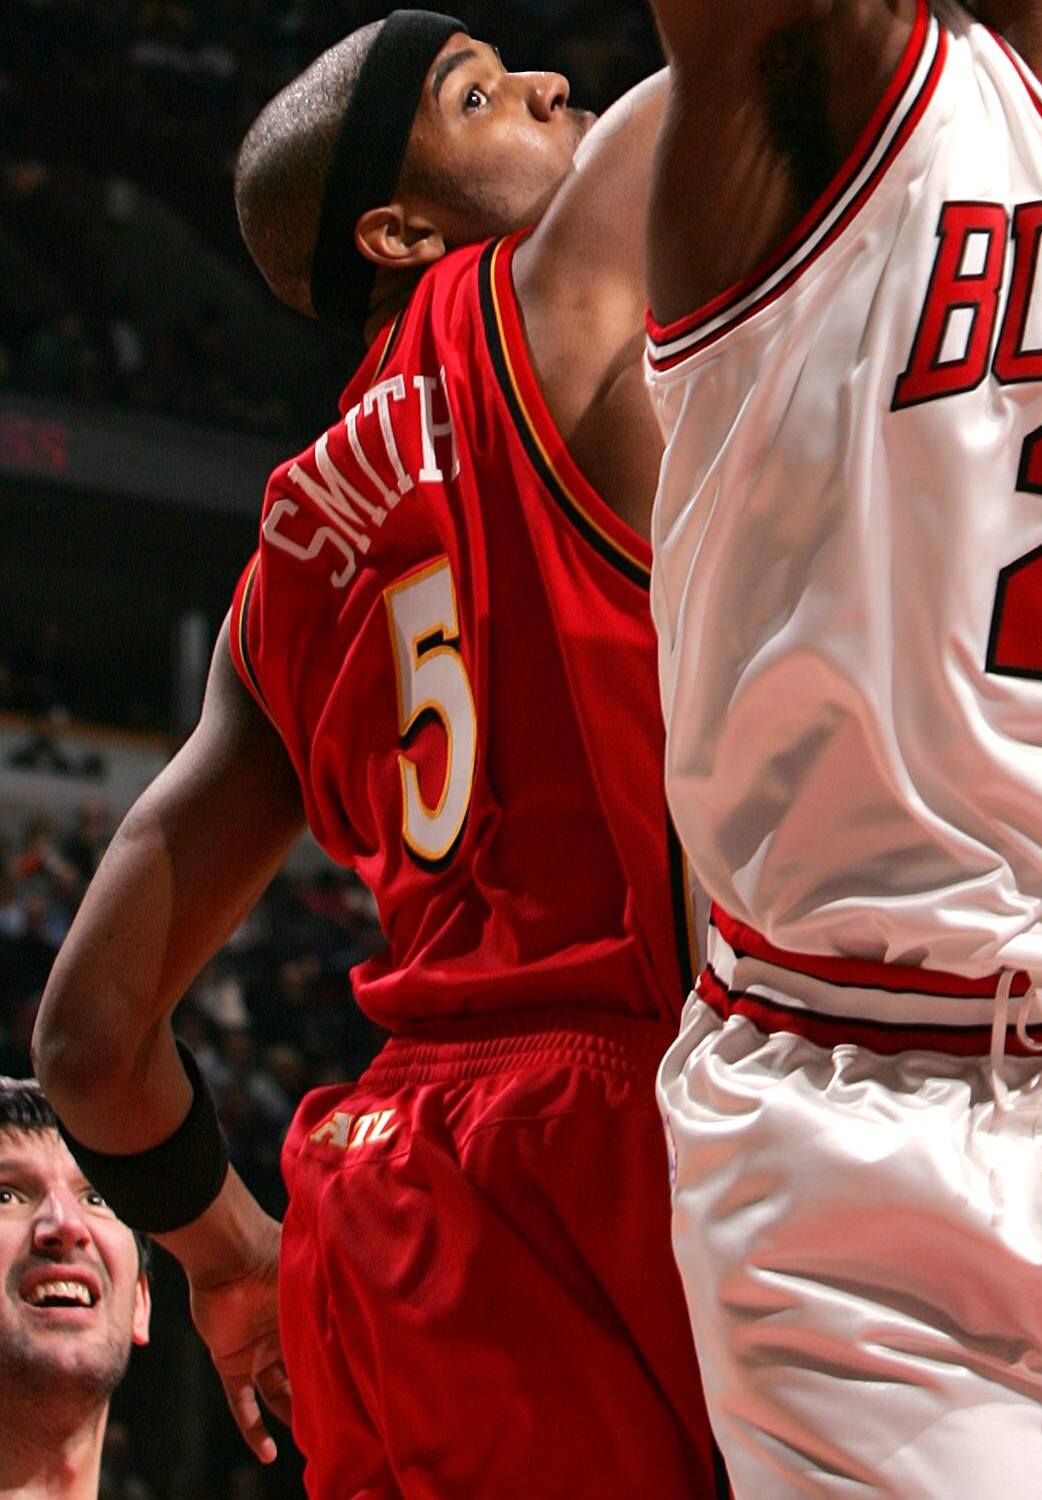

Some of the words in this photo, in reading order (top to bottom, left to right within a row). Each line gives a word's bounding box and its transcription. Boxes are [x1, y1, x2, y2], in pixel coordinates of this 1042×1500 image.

[262, 365, 460, 587] SMITH
[383, 557, 477, 872] 5
[309, 1108, 399, 1150] ATL
